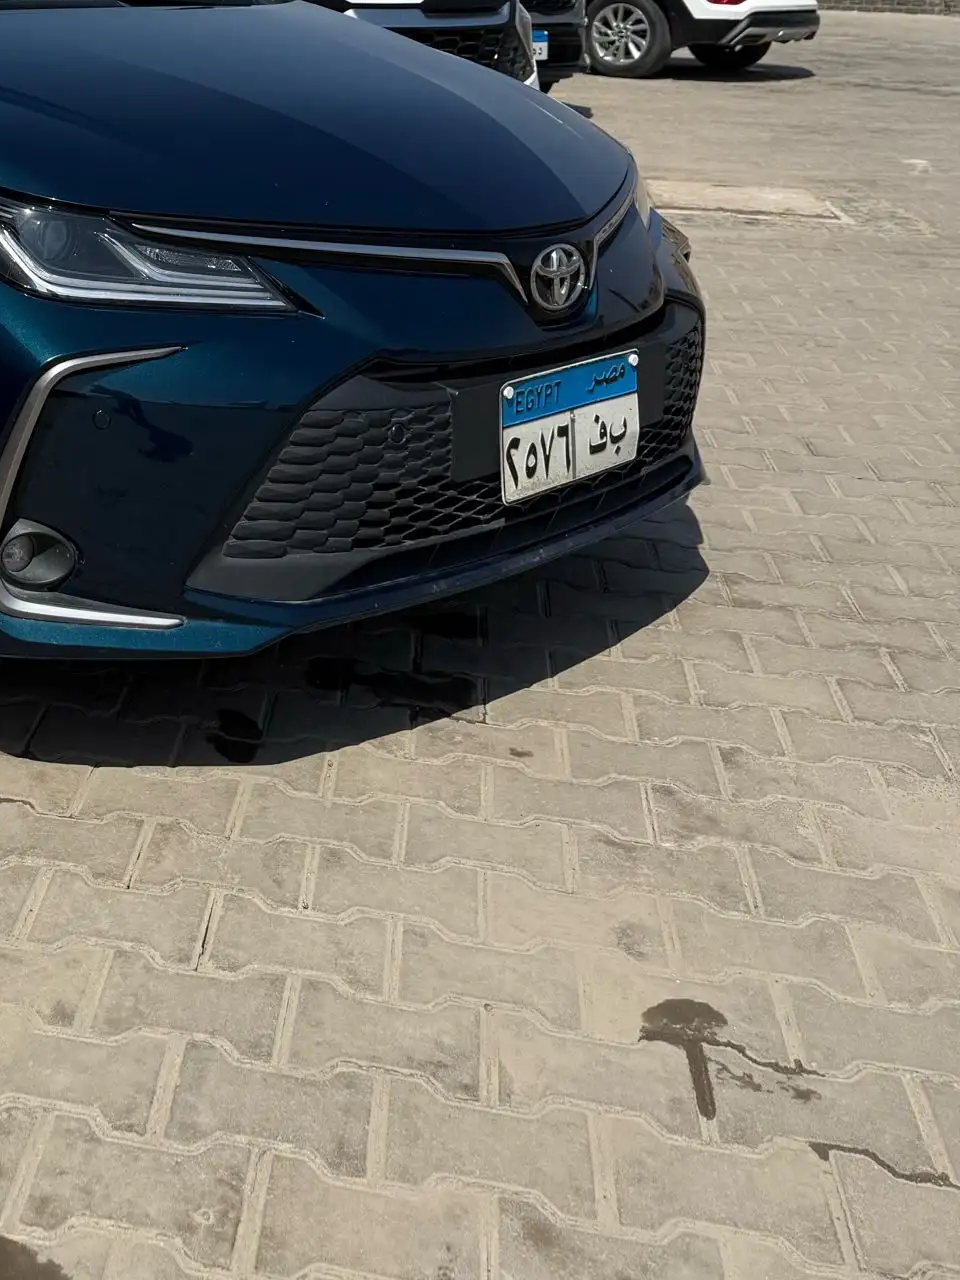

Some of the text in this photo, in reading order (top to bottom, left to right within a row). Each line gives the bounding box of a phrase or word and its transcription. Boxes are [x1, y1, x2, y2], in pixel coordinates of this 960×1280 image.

[586, 363, 626, 393] مصر
[514, 380, 562, 414] EGYPT
[505, 423, 571, 490] ٢٥٧٦
